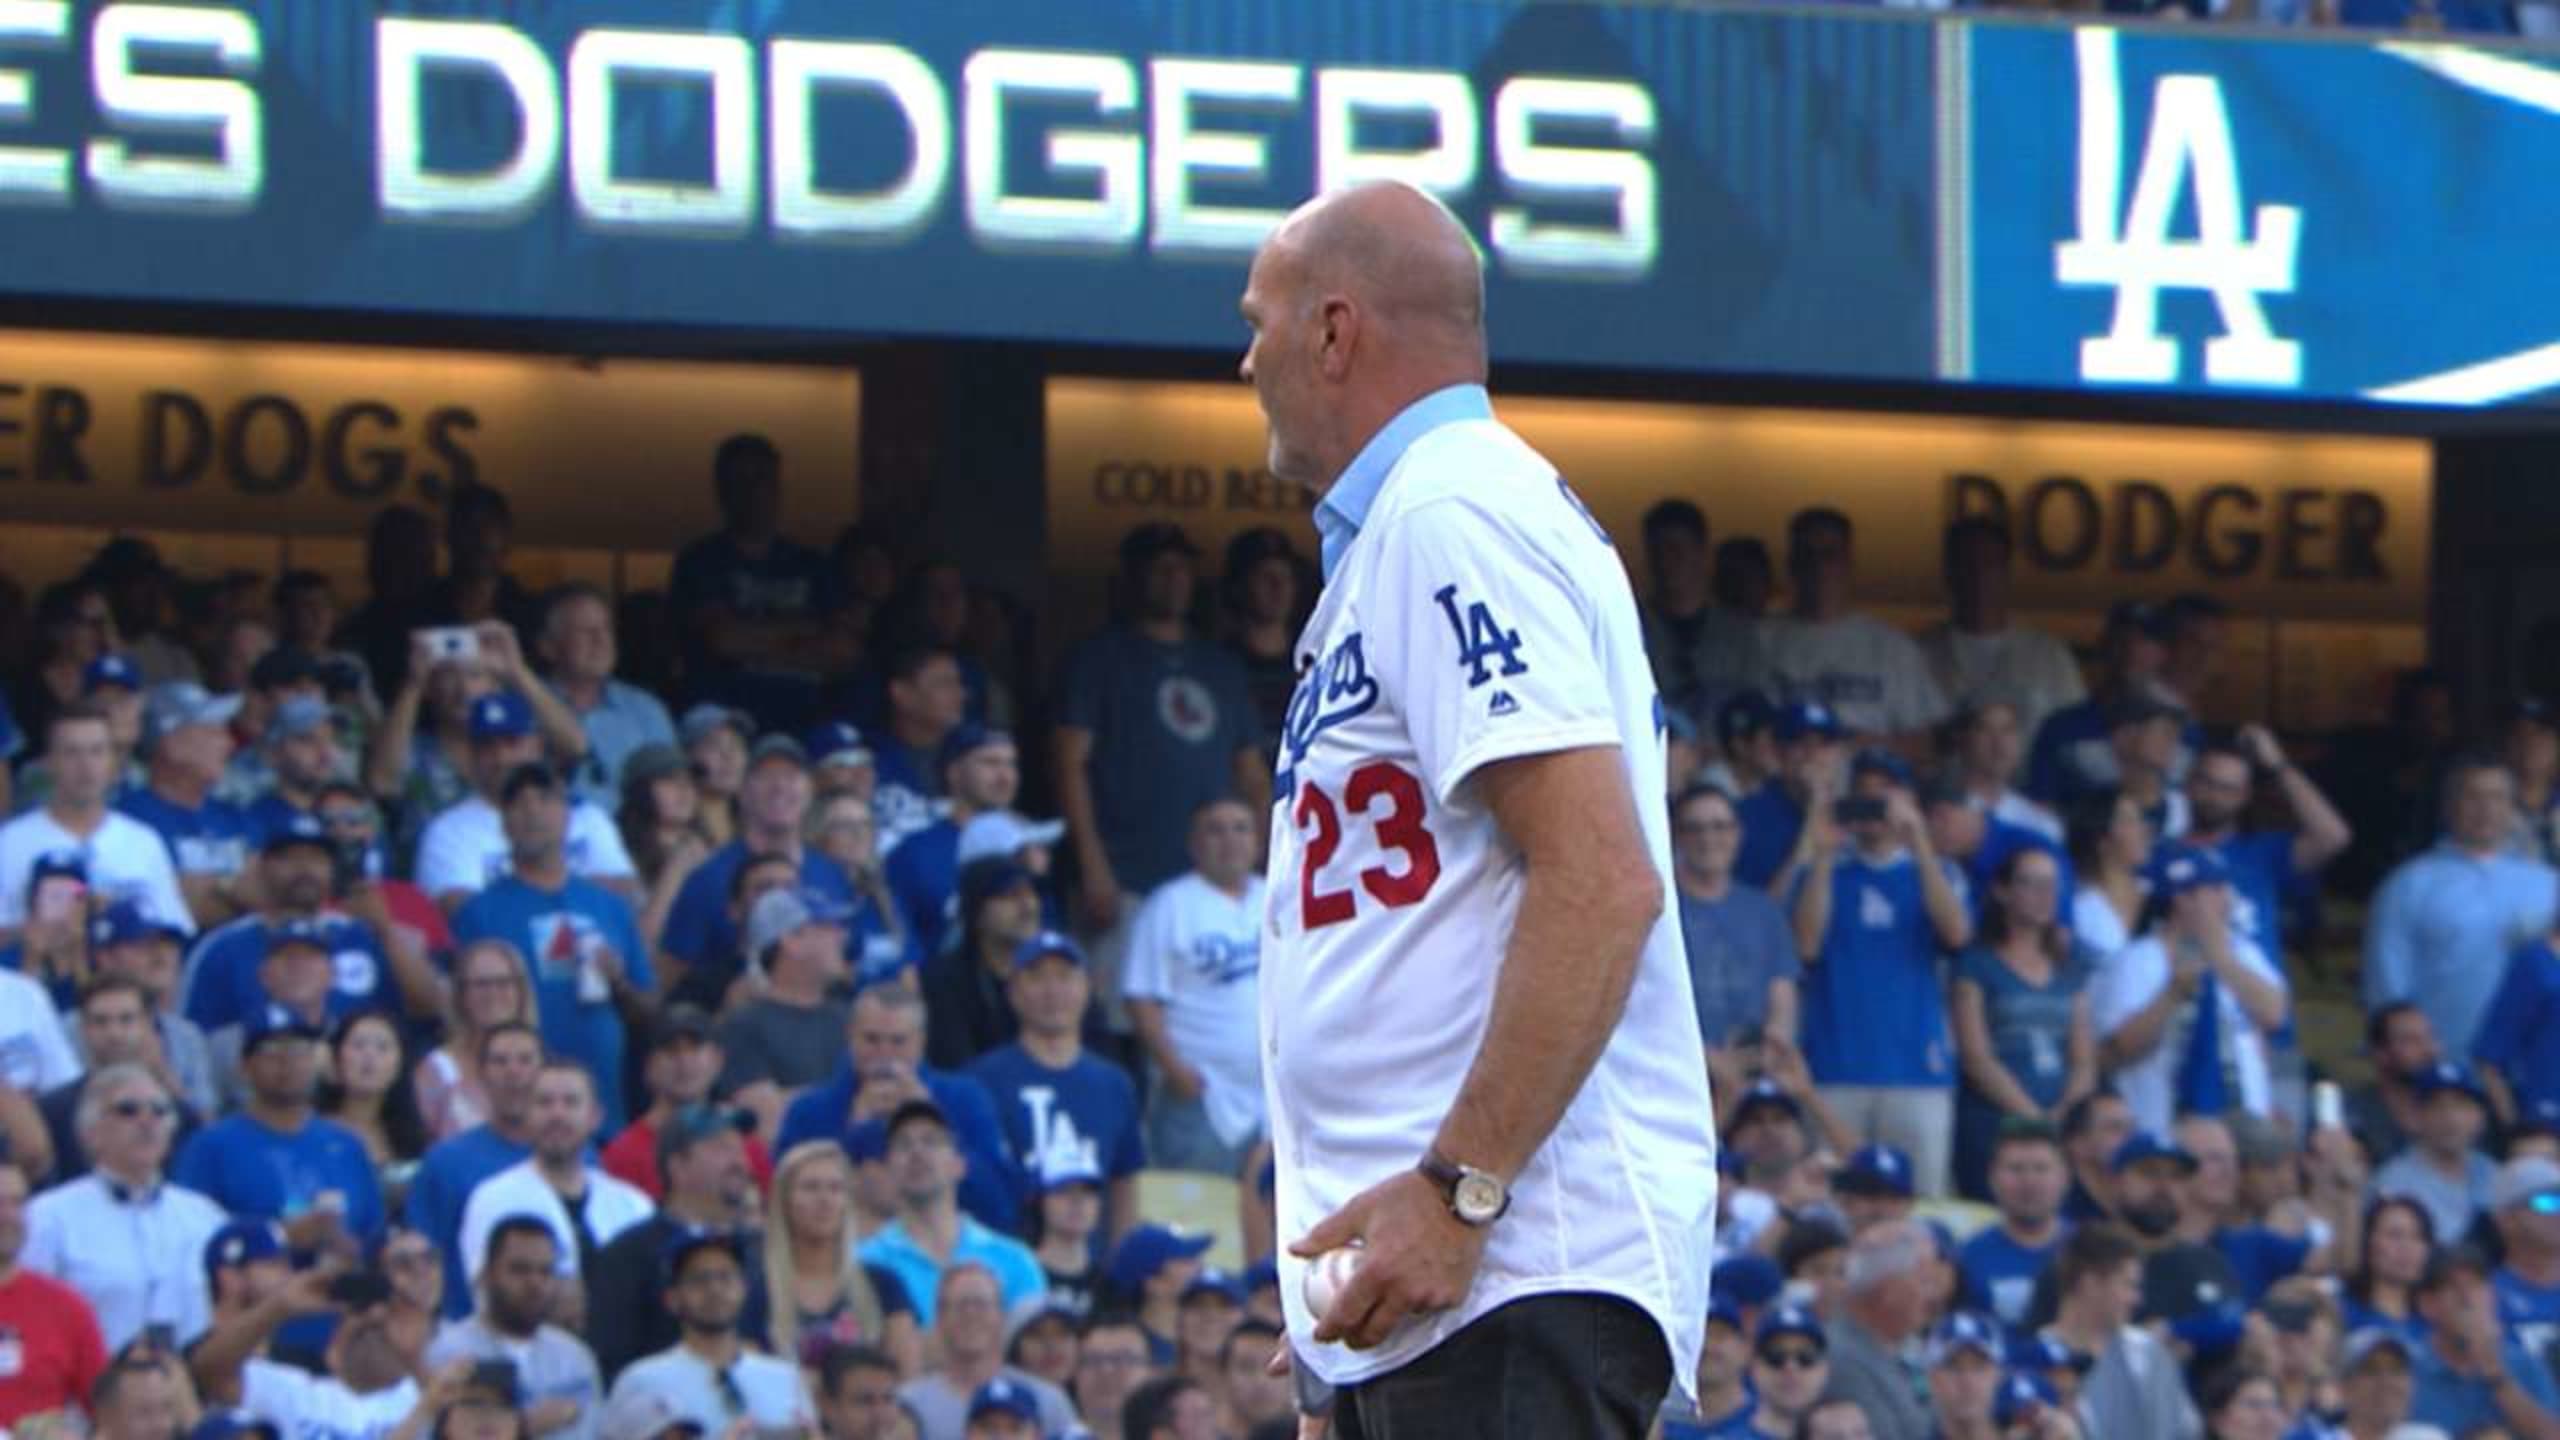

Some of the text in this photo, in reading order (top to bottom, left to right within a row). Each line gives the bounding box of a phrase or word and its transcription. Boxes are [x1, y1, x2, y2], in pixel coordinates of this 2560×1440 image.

[377, 17, 1661, 270] DODGERS
[2055, 24, 2303, 388] LA
[140, 388, 478, 502] DOGS
[1092, 461, 1214, 509] COLD
[1433, 583, 1528, 688] LA
[1296, 761, 1441, 932] 23
